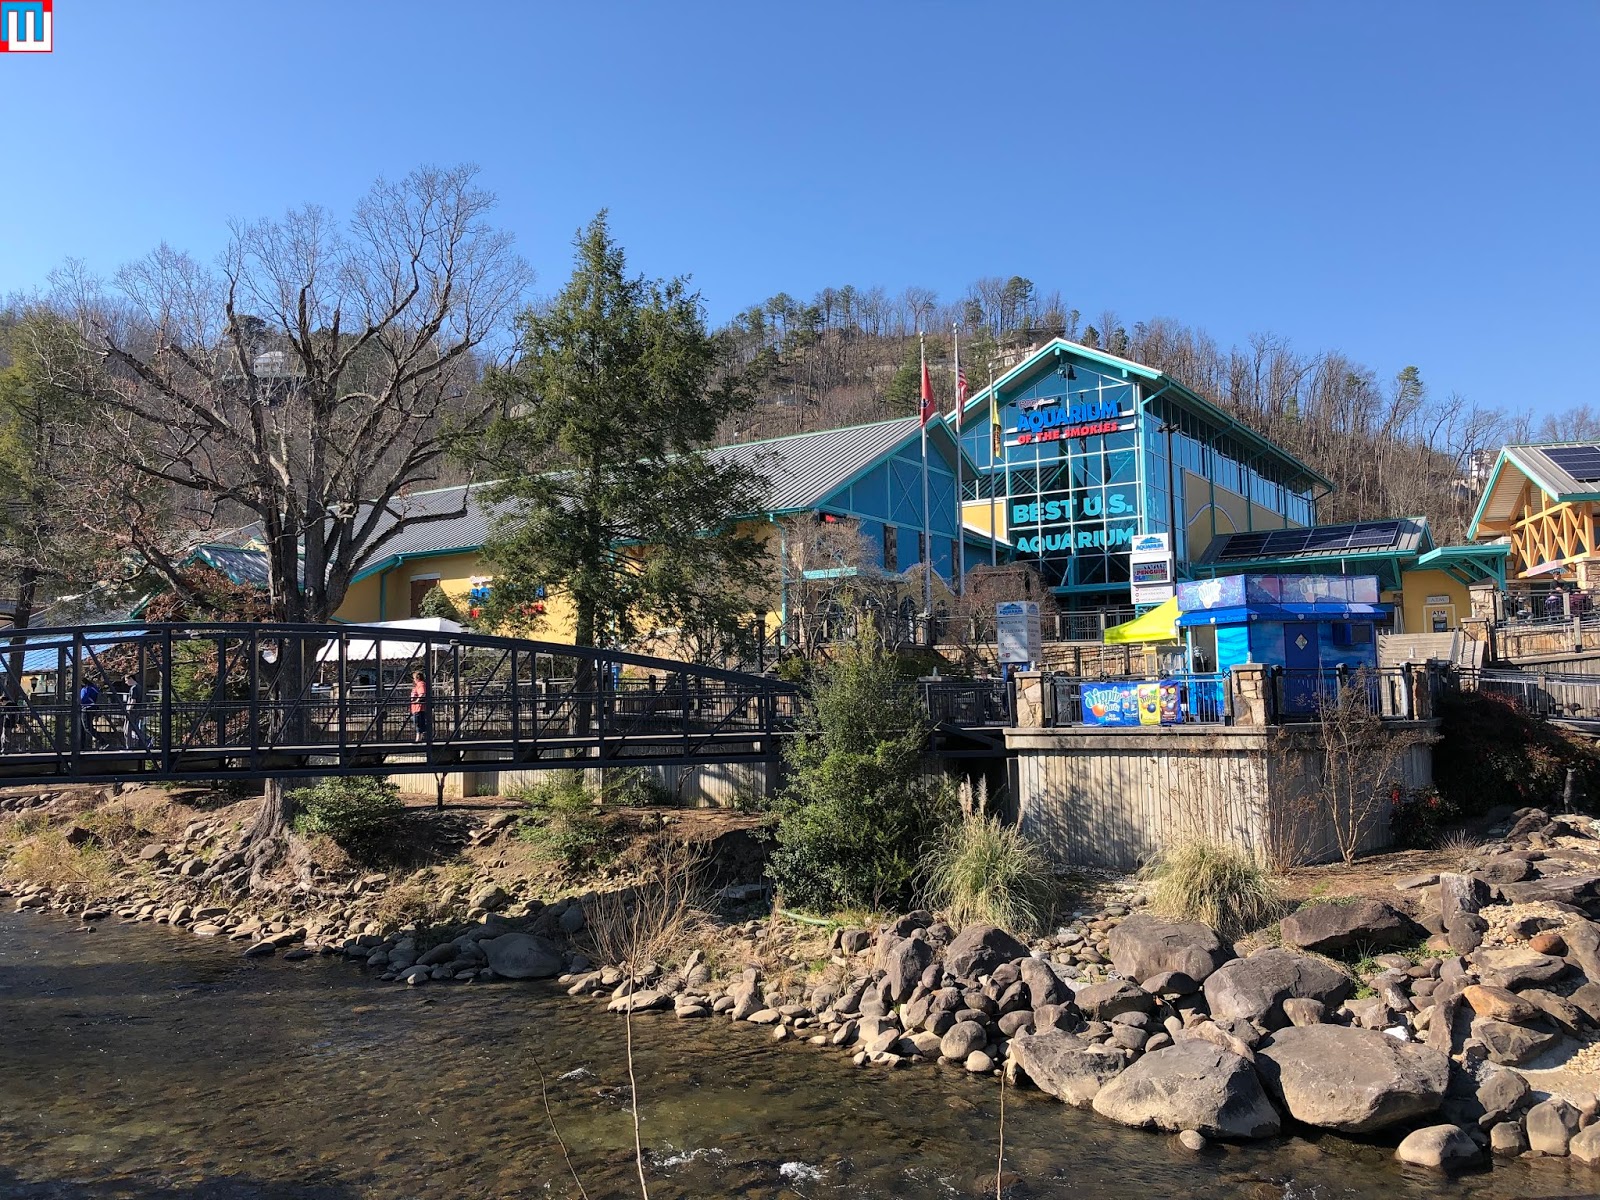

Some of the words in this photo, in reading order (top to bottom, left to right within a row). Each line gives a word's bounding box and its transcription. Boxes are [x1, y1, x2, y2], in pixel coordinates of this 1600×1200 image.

[1017, 400, 1119, 432] AQUARIUM
[1018, 434, 1032, 444] OF
[1036, 430, 1060, 442] THE
[1064, 421, 1118, 438] SMOKIES
[1013, 498, 1077, 524] BEST
[1083, 494, 1133, 516] U.S.
[1016, 527, 1134, 553] AQUARIUM
